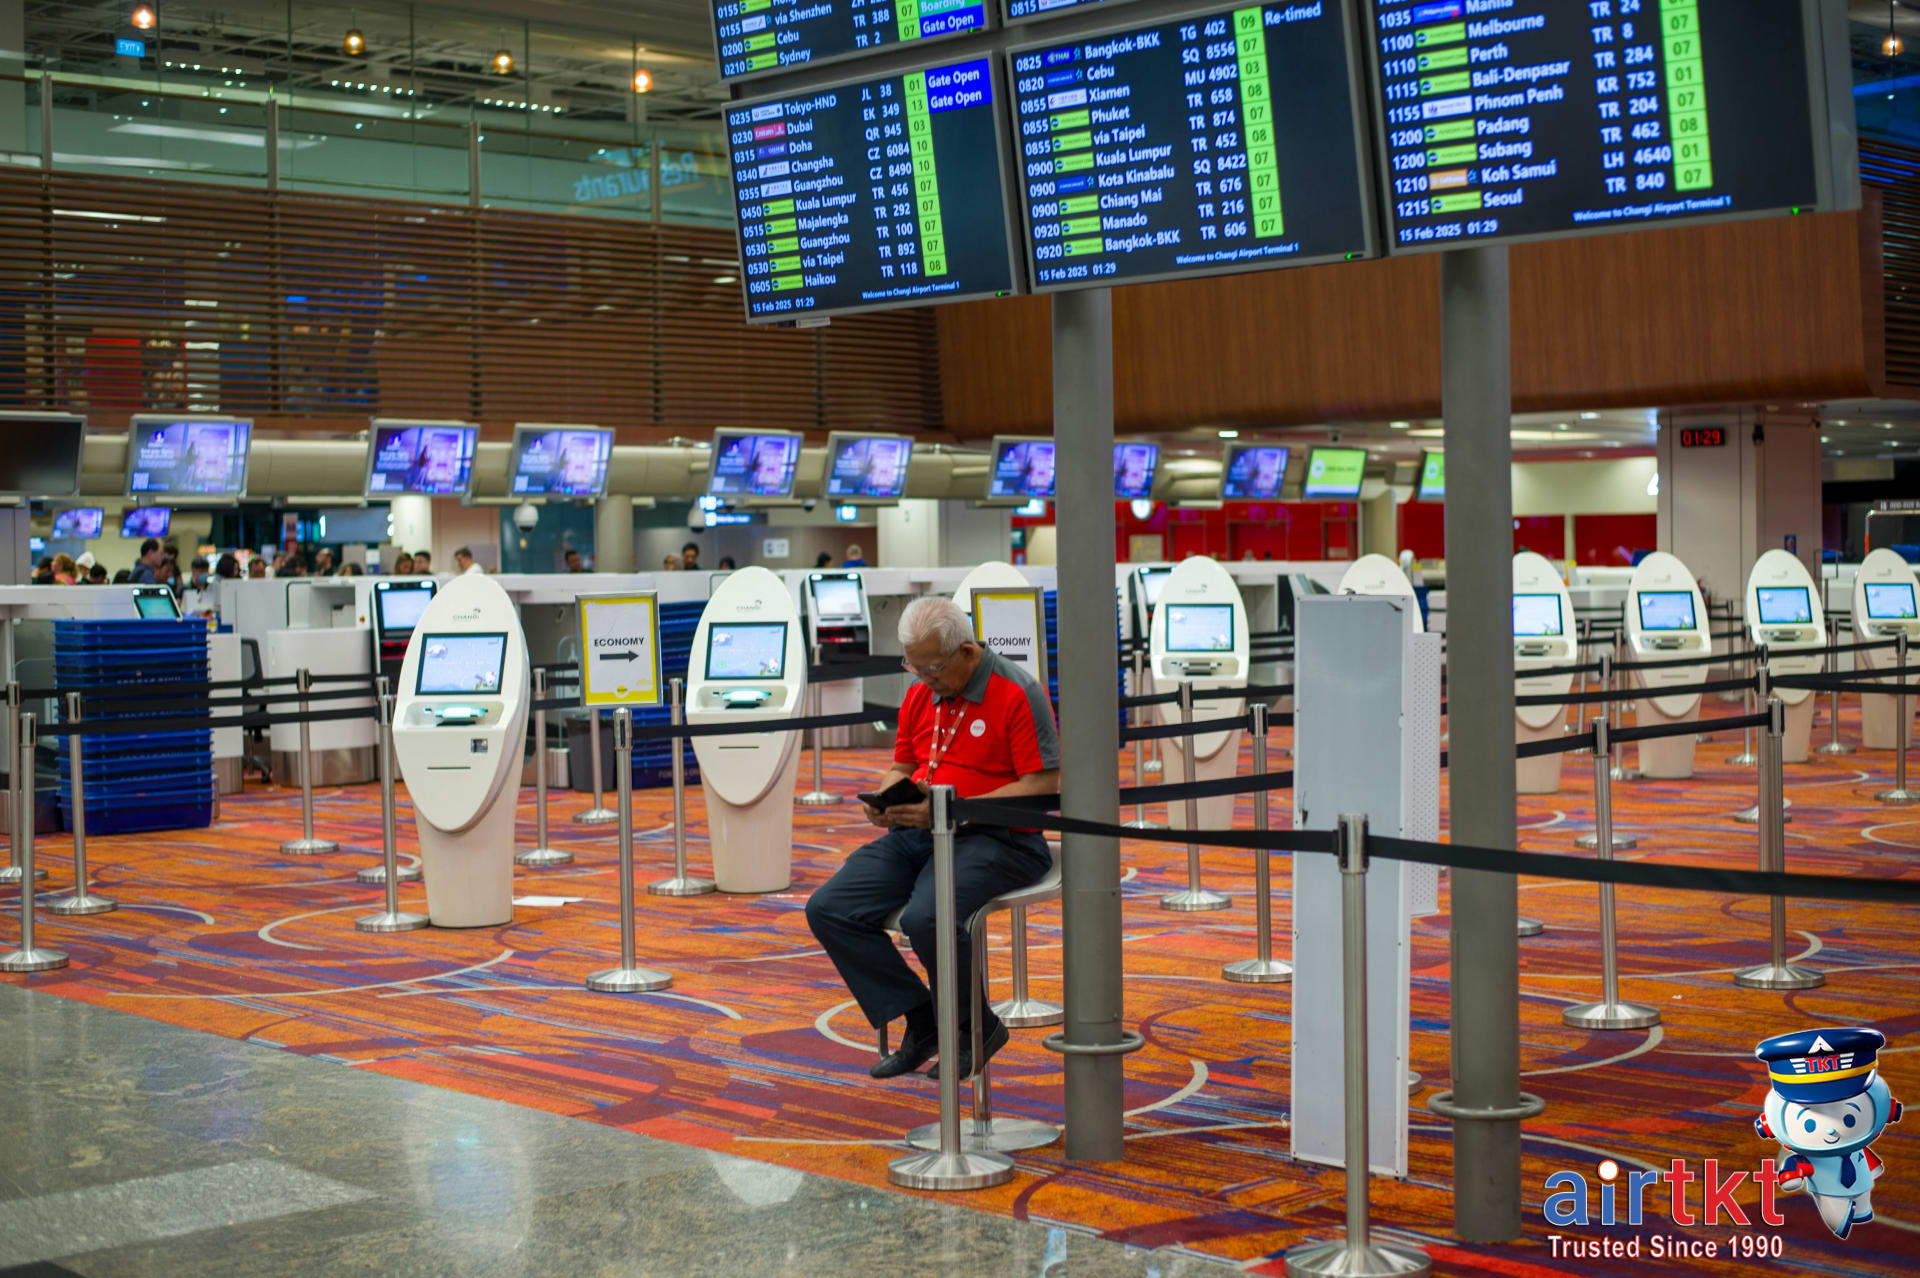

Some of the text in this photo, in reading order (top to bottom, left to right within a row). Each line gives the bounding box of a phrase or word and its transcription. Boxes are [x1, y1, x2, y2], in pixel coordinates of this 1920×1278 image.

[717, 3, 739, 19] 0155
[719, 22, 741, 38] 0155
[774, 11, 788, 26] via
[789, 3, 832, 23] Shenzhen
[1011, 1, 1037, 16] 0815
[1379, 9, 1412, 29] 1035
[722, 8, 890, 57] 0200 Cebu TR 388
[724, 14, 975, 76] 0210 Sydney TR 2 Gate Open
[1016, 54, 1042, 72] 0825
[1084, 31, 1160, 60] Bangkok-BKK
[1179, 25, 1197, 41] TG
[1203, 19, 1226, 37] 402
[1264, 1, 1322, 26] Re-timed
[1381, 33, 1414, 53] 1100
[1467, 14, 1545, 39] Melbourne
[1018, 40, 1236, 93] 0820 Cebu SQ 8556
[1383, 42, 1508, 77] 1110 Perth
[729, 69, 980, 126] 0235 Tokyo-HND JL 38 Gate Open
[1020, 63, 1238, 114] 0855 Xiamen MU 4902
[1386, 61, 1570, 100] 1115 Bali-Denpasar
[732, 130, 753, 145] 0230
[786, 118, 813, 135] Dubai
[863, 106, 876, 121] EK
[882, 102, 900, 118] 349
[930, 95, 954, 109] Gate
[954, 90, 983, 107] Open
[1023, 87, 1233, 136] 0855 Phuket TR 658
[1388, 84, 1564, 124] 1155 Phnom Penh
[734, 122, 902, 164] 0315 Doha QR 945
[1025, 109, 1236, 156] 0855 via Taipei TR 874
[1390, 116, 1530, 147] 1200 Padang
[736, 141, 910, 183] 0340 Changsha CZ 6084
[1027, 132, 1238, 177] 0900 Kuala Lumpur TR 452
[1392, 141, 1533, 171] 1200 Subang
[738, 161, 912, 201] 0355 Guangzhou CZ 8490
[1029, 153, 1247, 198] 0900 Kota Kinabalu SQ 8422
[1395, 159, 1557, 194] 1210 Koh Samui
[741, 182, 909, 220] 0450 Kuala Lumpur TR 456
[1031, 176, 1243, 218] 0900 Chiang Mai TR 676
[1397, 187, 1523, 217] 1215 Seoul
[743, 202, 911, 238] 0515 Majalengka TR 292
[1034, 198, 1245, 239] 0920 Manado TR 216
[745, 222, 913, 257] 0530 Guangzhou TR 100
[747, 242, 916, 275] 0530 via Taipei TR 892
[1036, 221, 1247, 260] 0920 Bangkok-BKK TR 606
[749, 261, 918, 294] 0605 Haikou TR 118
[862, 290, 886, 299] Welcome
[892, 287, 912, 297] Changi
[911, 284, 932, 295] Airport
[931, 281, 956, 292] Terminal
[1039, 262, 1117, 281] 15 Feb 2025 01:29
[752, 296, 815, 313] 15 Feb 2025 01:29
[1683, 430, 1721, 446] 01:29
[594, 637, 645, 647] ECONOMY
[988, 637, 1031, 646] ECONOMY
